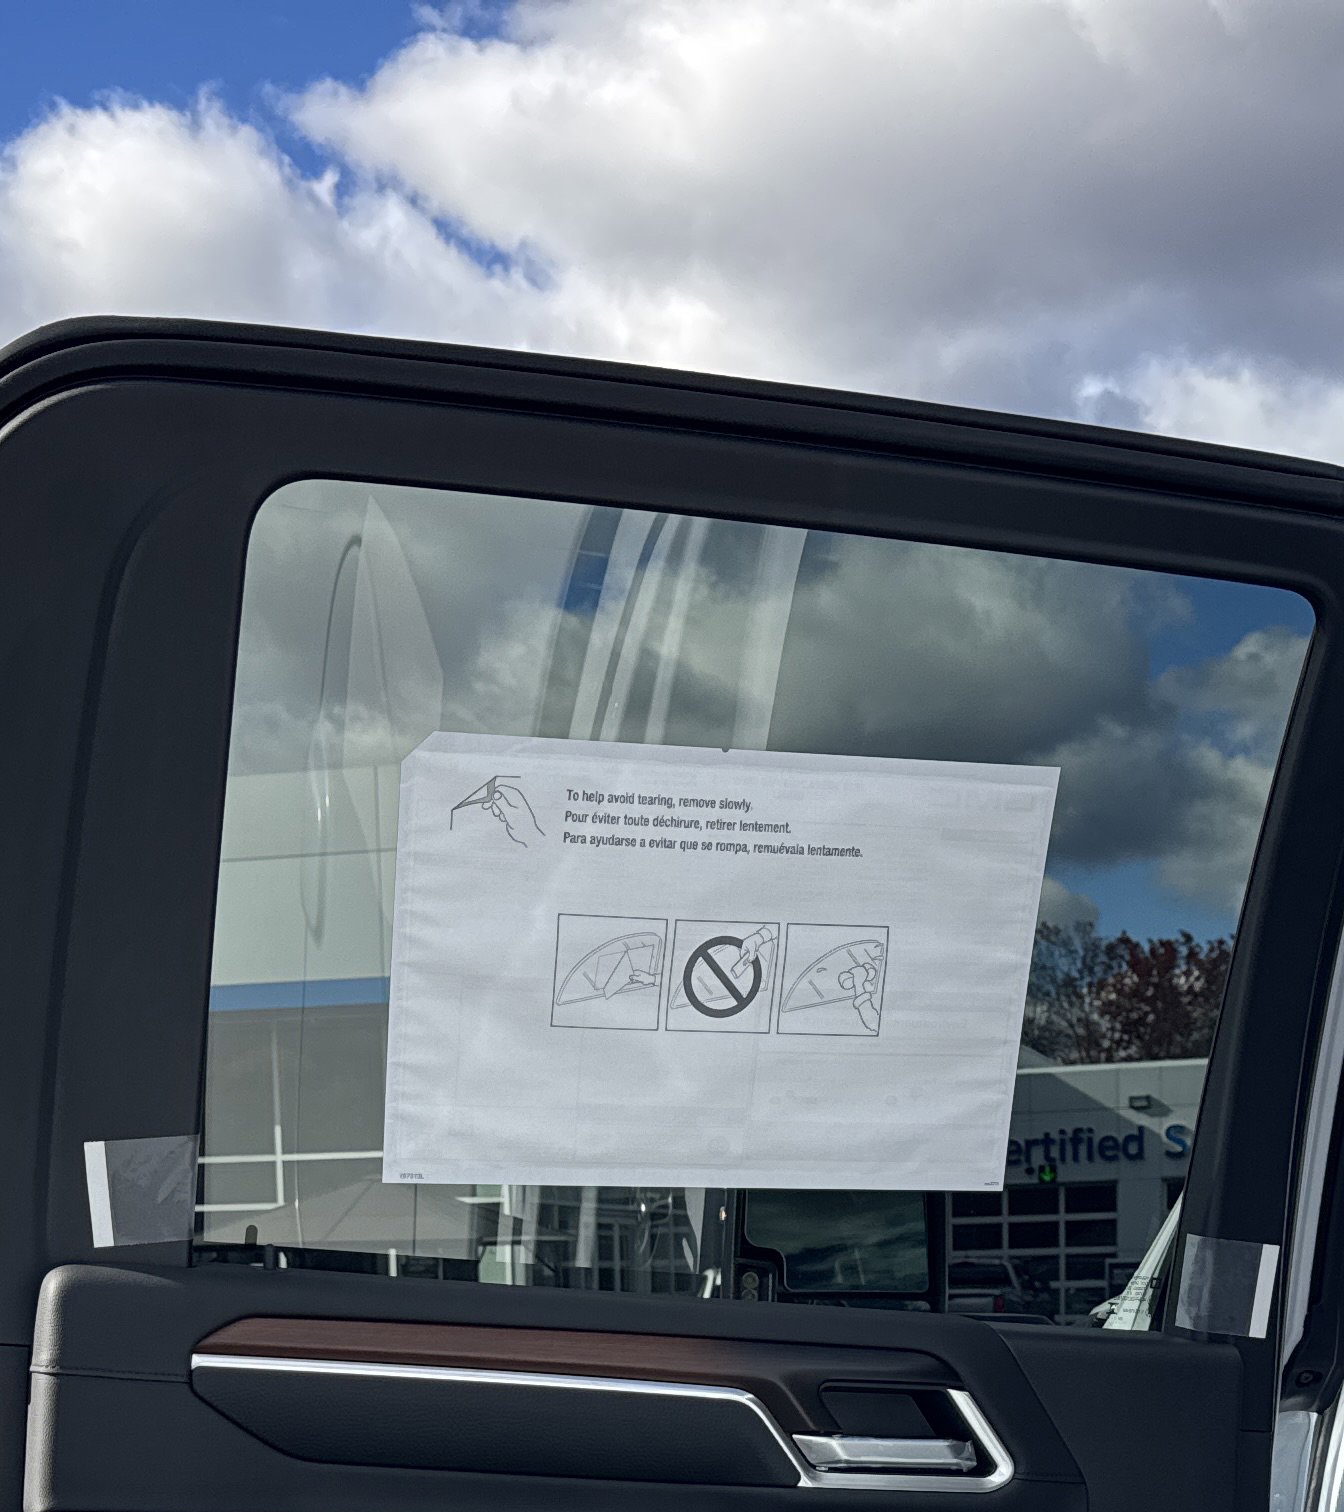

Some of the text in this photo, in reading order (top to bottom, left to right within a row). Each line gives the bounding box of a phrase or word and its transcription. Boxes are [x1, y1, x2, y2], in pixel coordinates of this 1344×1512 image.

[566, 788, 579, 801] To
[582, 789, 605, 805] help
[607, 791, 635, 804] avoid
[637, 793, 676, 809] tearing,
[678, 797, 716, 809] remove
[564, 810, 792, 834] Pour éviter toute déchirure, retirer lentement.
[563, 831, 864, 859] Para ayudarse a evitar que se rompa, remuévala lentamente.
[1007, 1125, 1145, 1166] ertified
